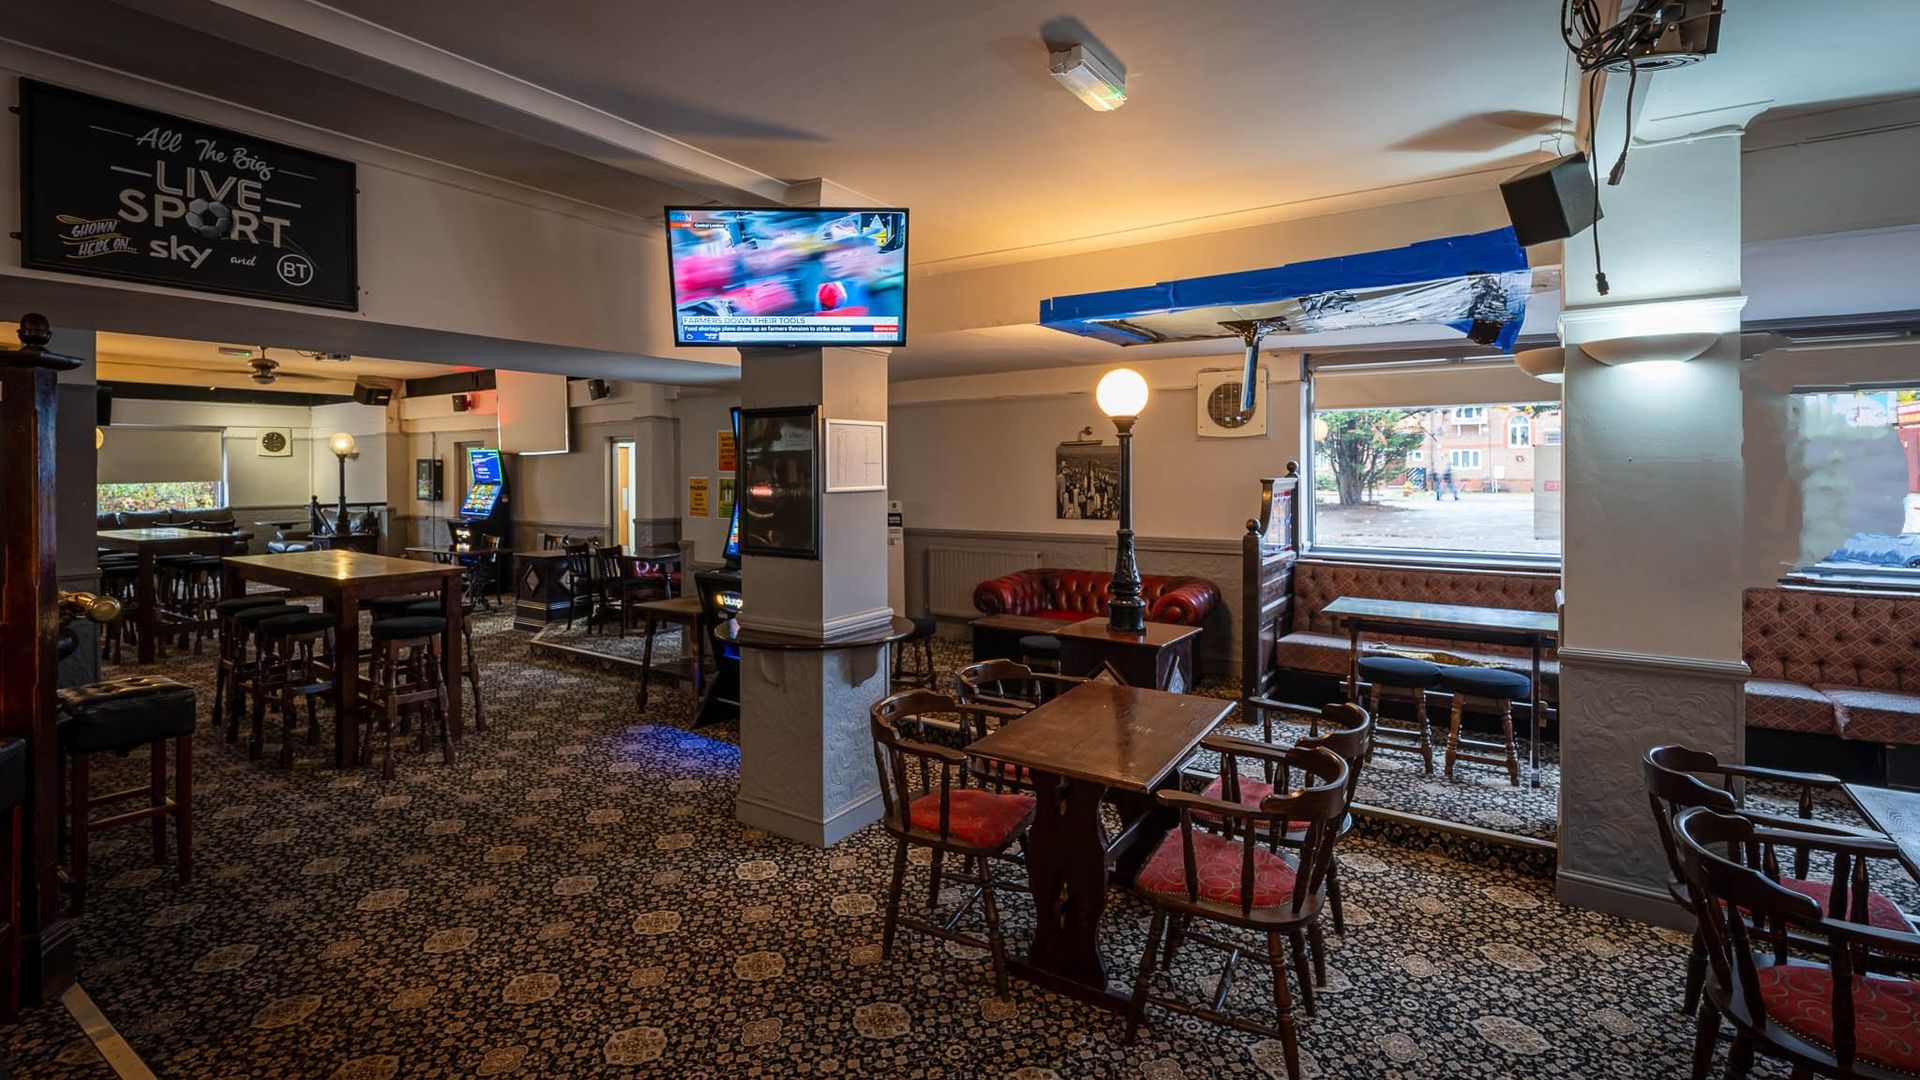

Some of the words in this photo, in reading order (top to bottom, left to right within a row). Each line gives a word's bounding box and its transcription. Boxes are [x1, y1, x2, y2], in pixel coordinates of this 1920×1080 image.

[136, 127, 183, 153] All
[195, 139, 229, 163] The
[233, 147, 275, 182] Big
[156, 159, 263, 213] LIVE
[71, 221, 119, 238] SHOWN
[78, 238, 109, 257] HERE
[150, 235, 214, 270] sky
[230, 255, 257, 267] and
[283, 261, 308, 279] BT
[723, 595, 743, 609] bluep
